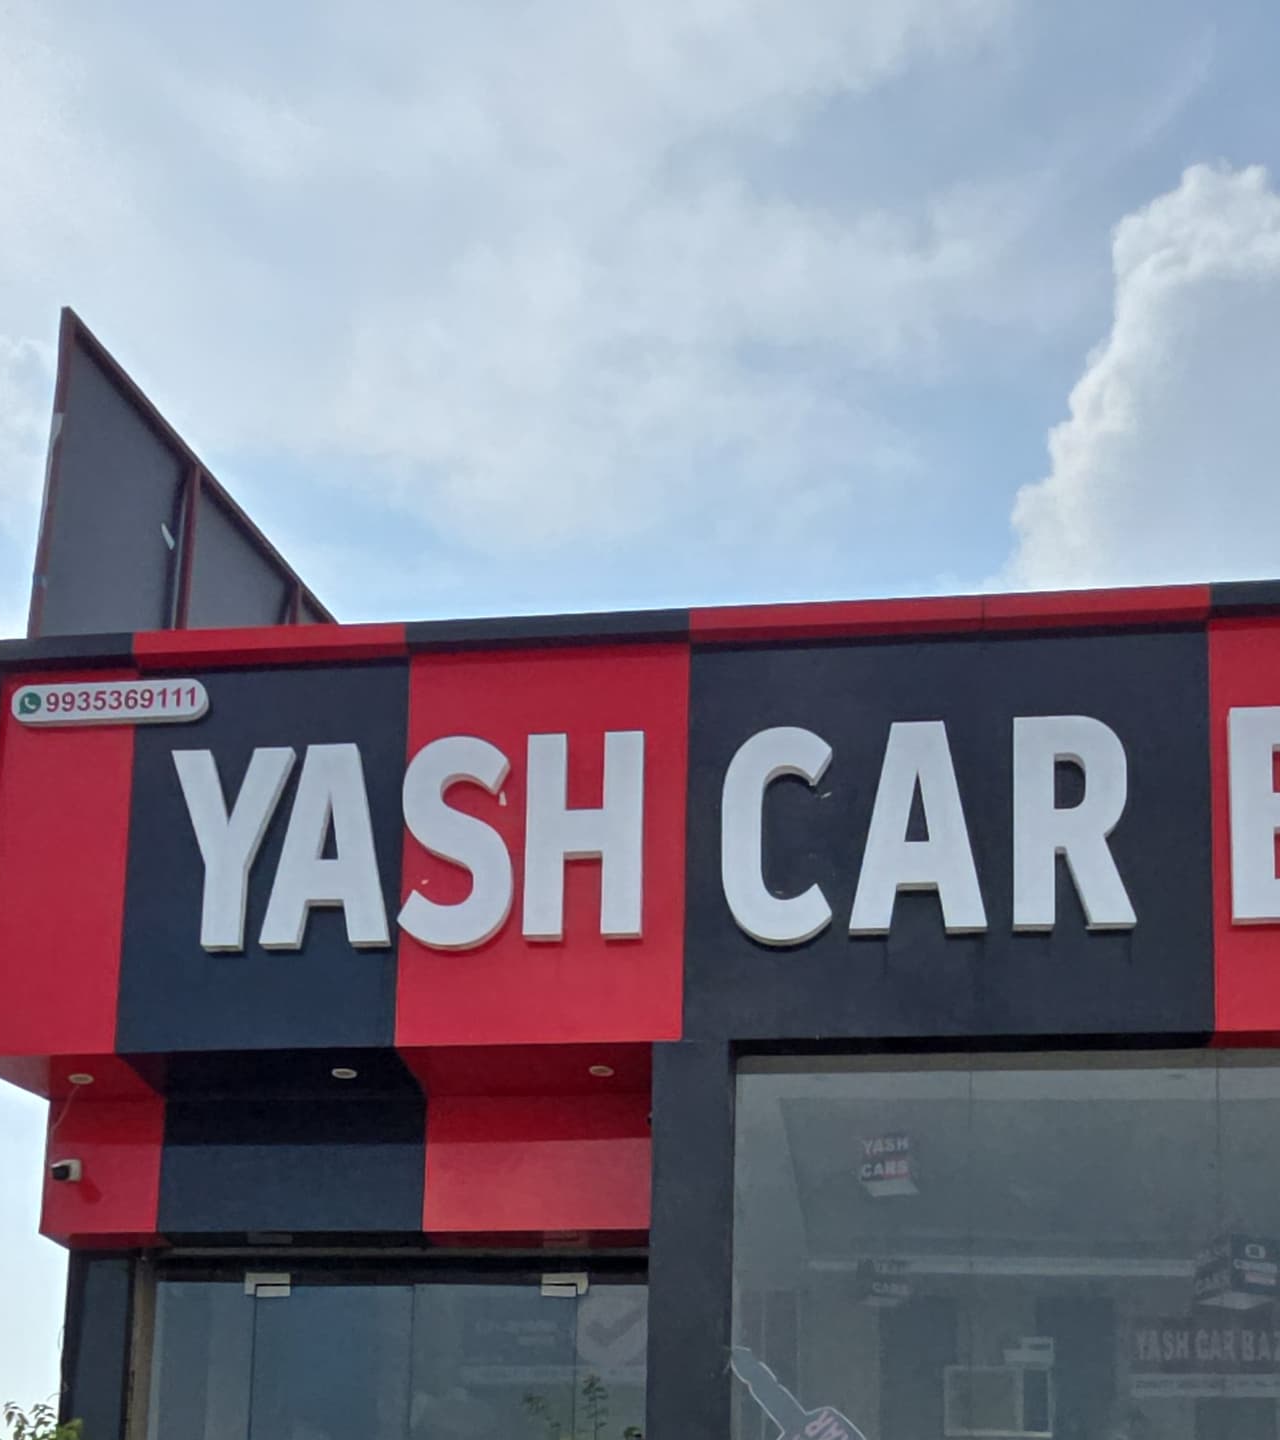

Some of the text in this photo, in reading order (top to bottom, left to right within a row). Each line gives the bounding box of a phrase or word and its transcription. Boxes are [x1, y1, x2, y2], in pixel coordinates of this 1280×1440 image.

[46, 686, 197, 712] 9935369111
[172, 730, 645, 952] YASH
[721, 715, 1138, 946] CAR
